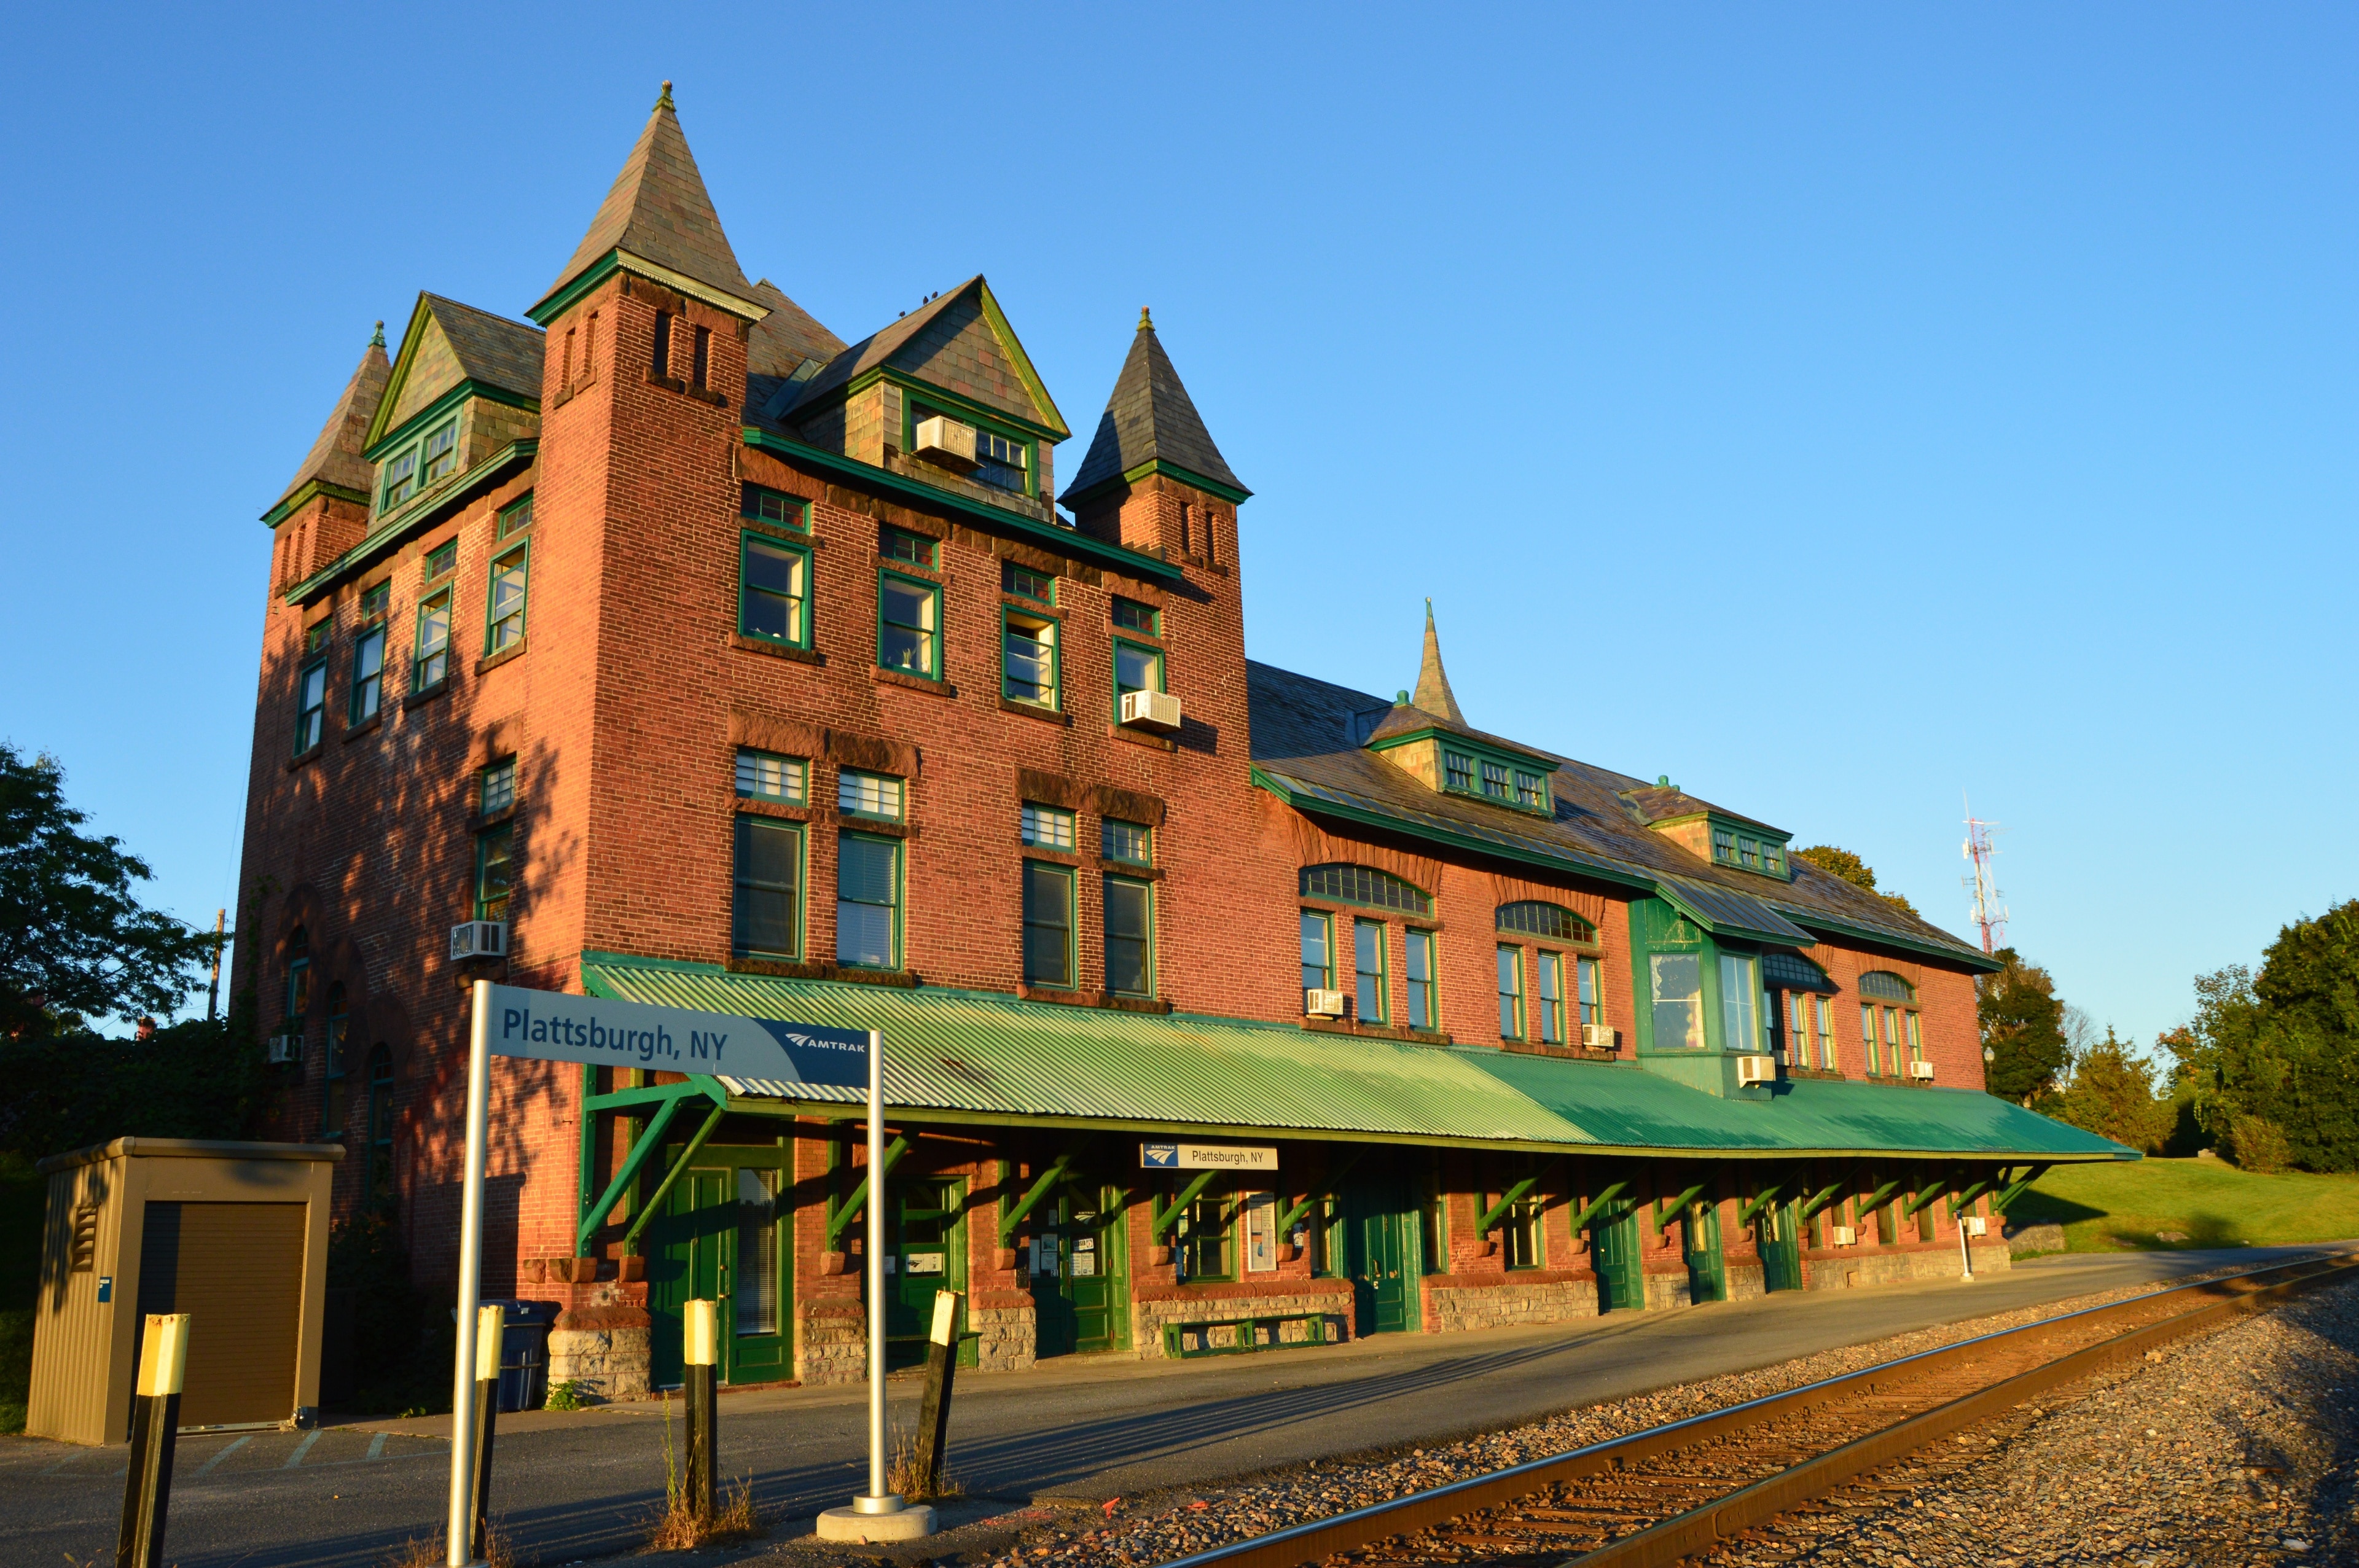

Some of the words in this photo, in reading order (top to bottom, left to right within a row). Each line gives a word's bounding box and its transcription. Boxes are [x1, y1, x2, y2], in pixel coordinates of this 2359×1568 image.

[504, 1008, 680, 1061] Plattsburgh,
[690, 1031, 728, 1061] NY
[808, 1039, 865, 1053] AMTRAK
[1192, 1150, 1248, 1164] Plattsburgh,
[1251, 1152, 1263, 1163] NY
